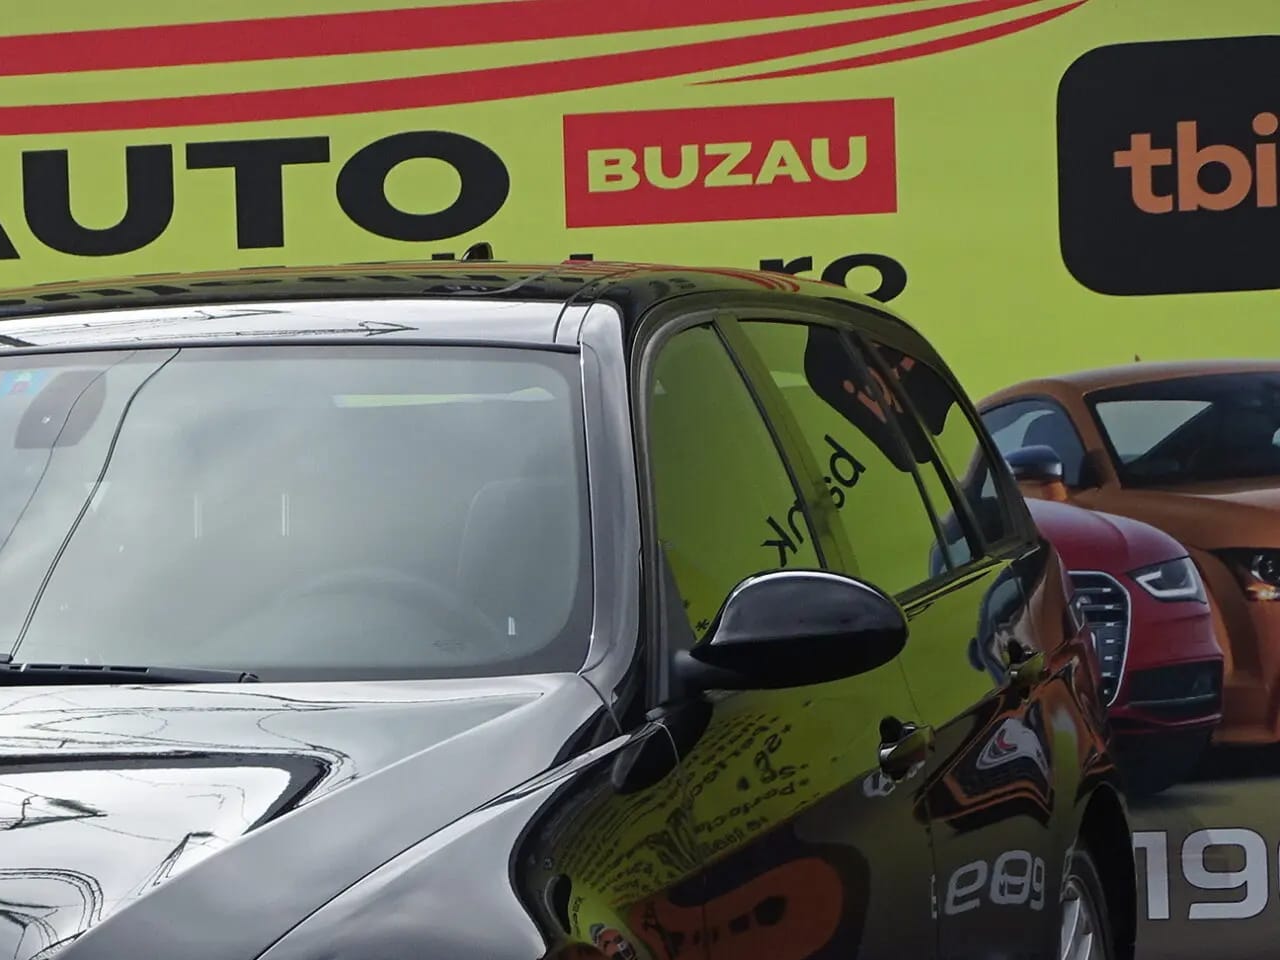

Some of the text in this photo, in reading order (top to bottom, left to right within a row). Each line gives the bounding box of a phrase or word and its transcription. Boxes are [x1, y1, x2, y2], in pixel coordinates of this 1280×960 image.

[587, 135, 868, 193] BUZAU
[1113, 112, 1280, 214] tbi
[1131, 828, 1280, 920] 19
